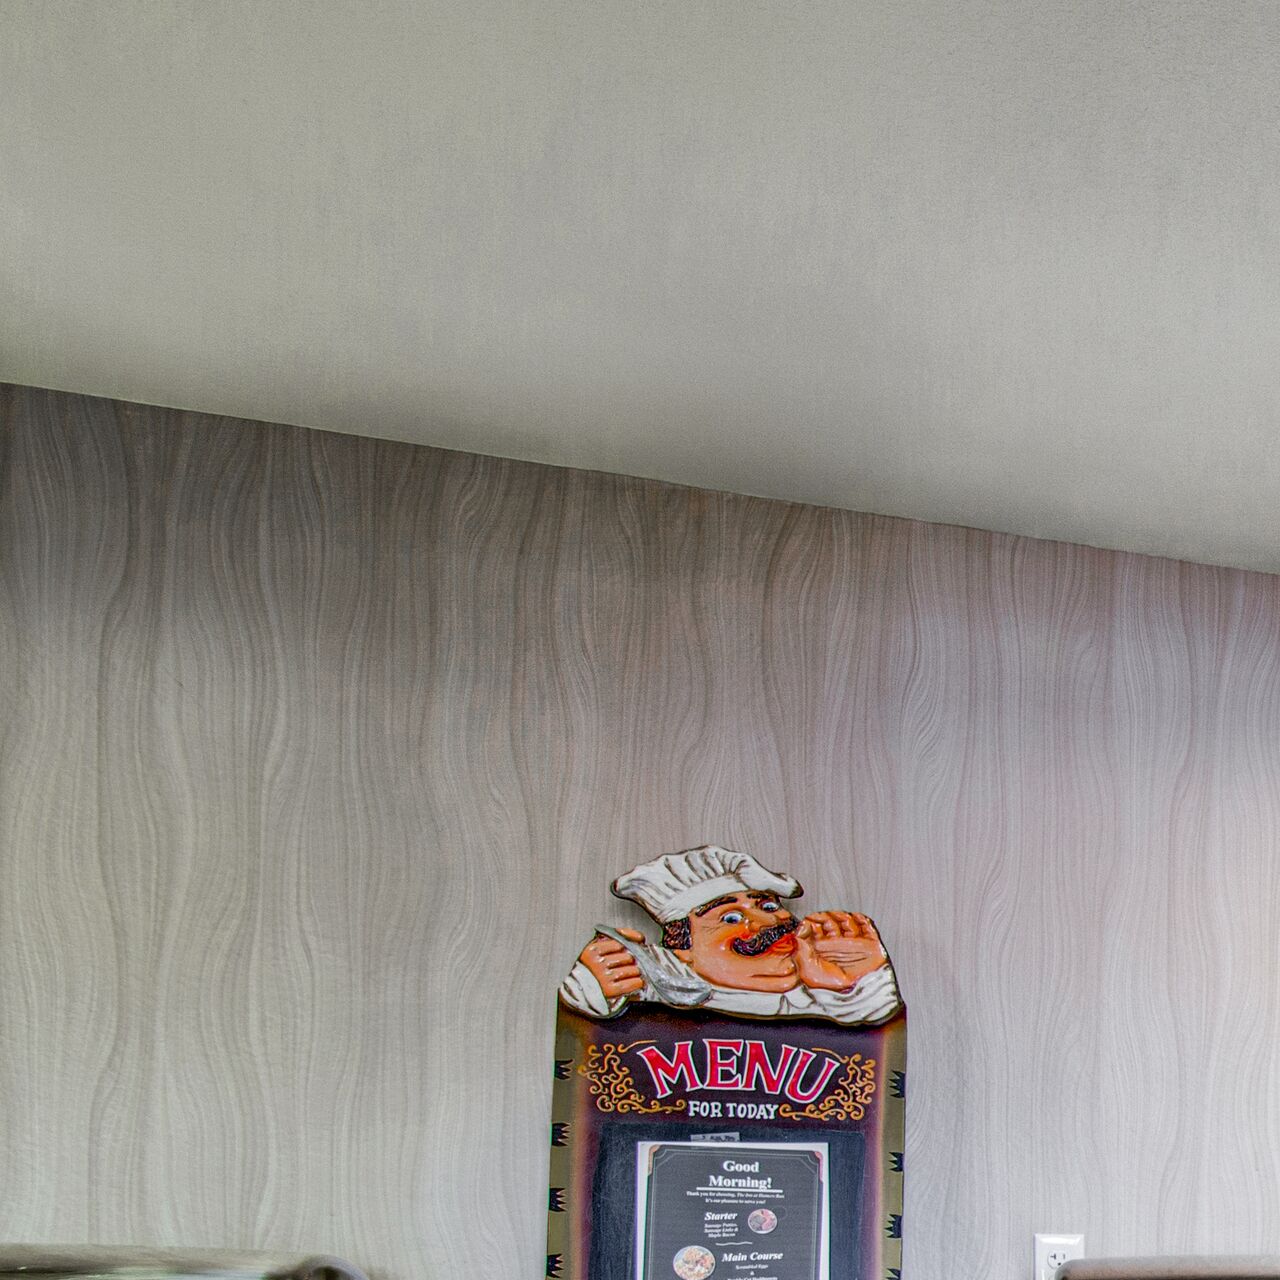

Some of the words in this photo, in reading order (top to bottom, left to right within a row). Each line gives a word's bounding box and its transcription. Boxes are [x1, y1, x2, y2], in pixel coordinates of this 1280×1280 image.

[637, 1038, 840, 1103] MENU
[689, 1101, 722, 1118] FOR
[726, 1102, 779, 1119] TODAY
[723, 1160, 760, 1173] Good
[709, 1175, 772, 1190] Morning!
[704, 1211, 738, 1221] Starter
[722, 1253, 748, 1263] Main
[750, 1252, 784, 1261] Course
